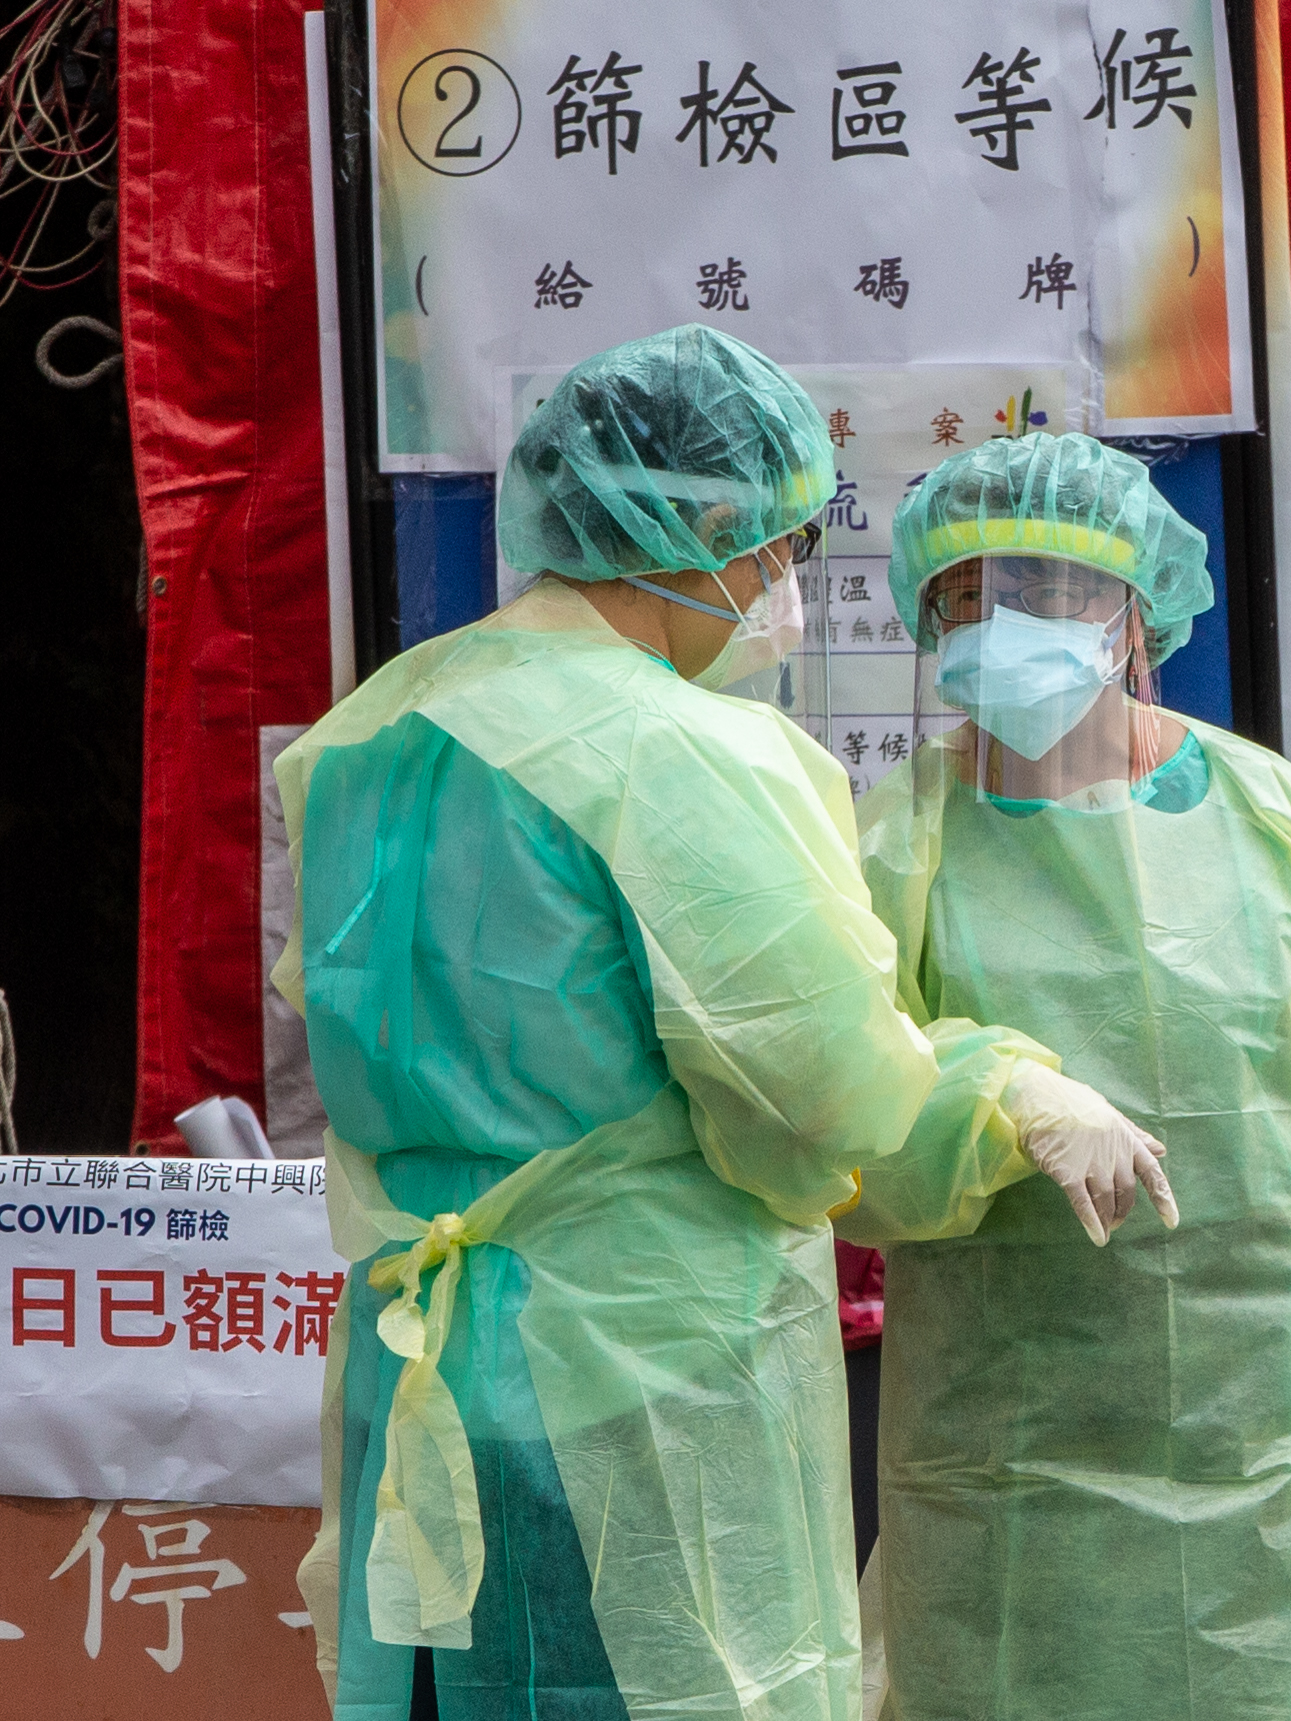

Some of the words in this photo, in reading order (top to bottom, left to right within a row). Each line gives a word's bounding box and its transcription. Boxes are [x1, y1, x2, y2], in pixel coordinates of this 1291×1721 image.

[814, 730, 927, 765] 等候
[0, 1203, 156, 1236] COVID-19
[166, 1208, 230, 1241] 篩檢
